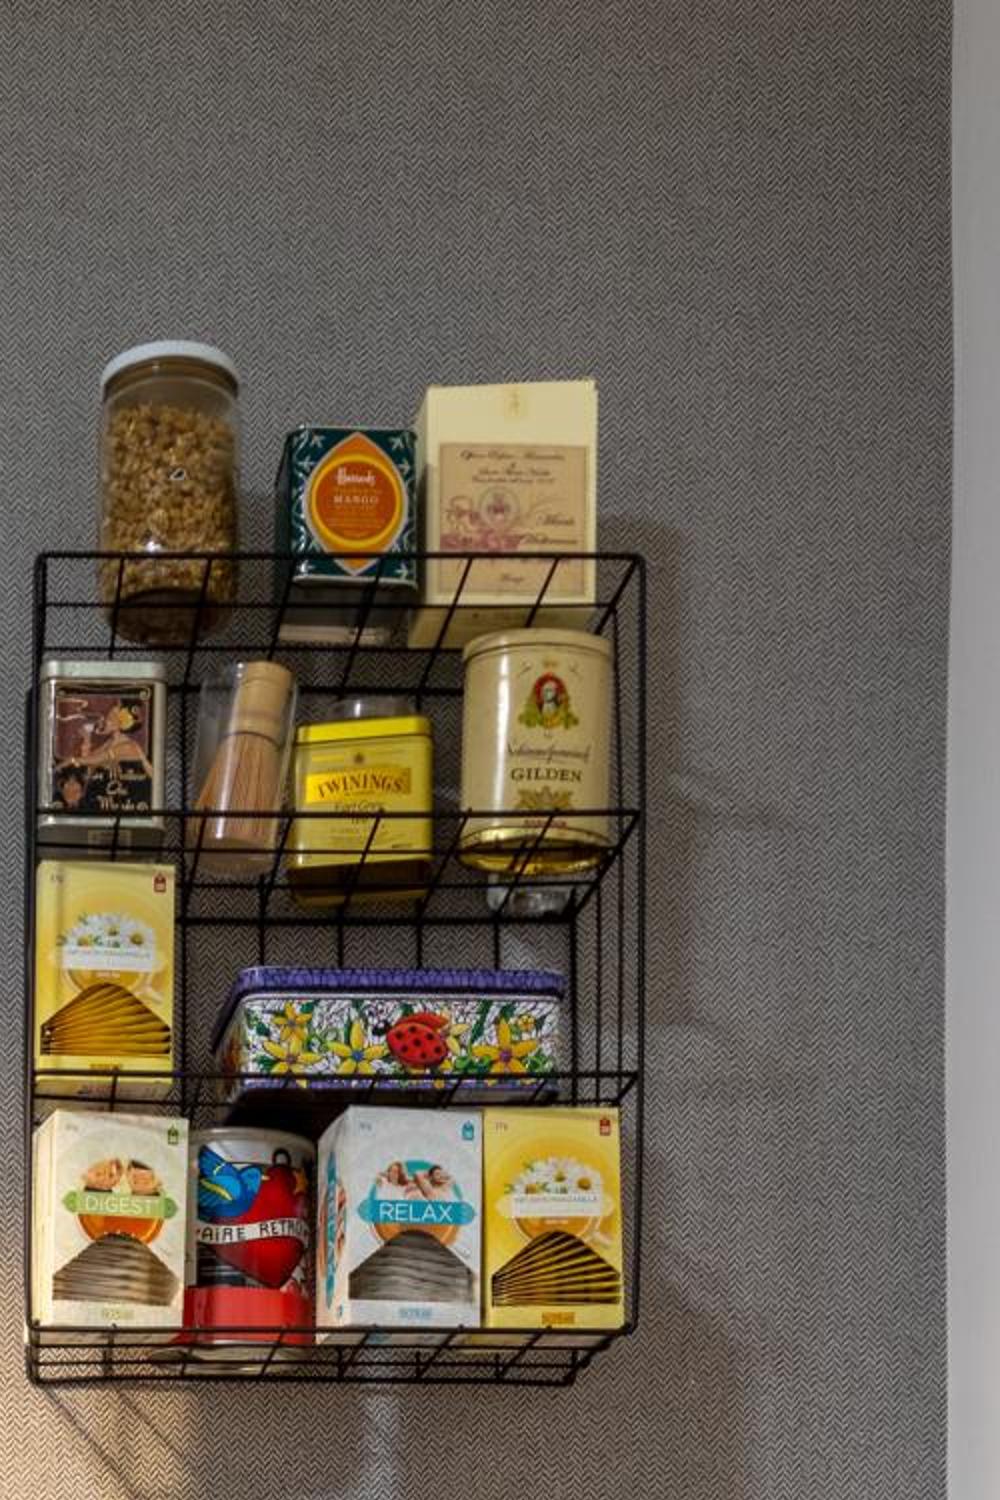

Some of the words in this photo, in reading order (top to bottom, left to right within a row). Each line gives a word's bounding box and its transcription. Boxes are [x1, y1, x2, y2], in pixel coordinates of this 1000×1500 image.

[511, 767, 583, 782] GILDEN
[317, 773, 403, 798] TWININGS
[85, 1195, 154, 1214] DIGEST
[379, 1202, 453, 1222] RELAX
